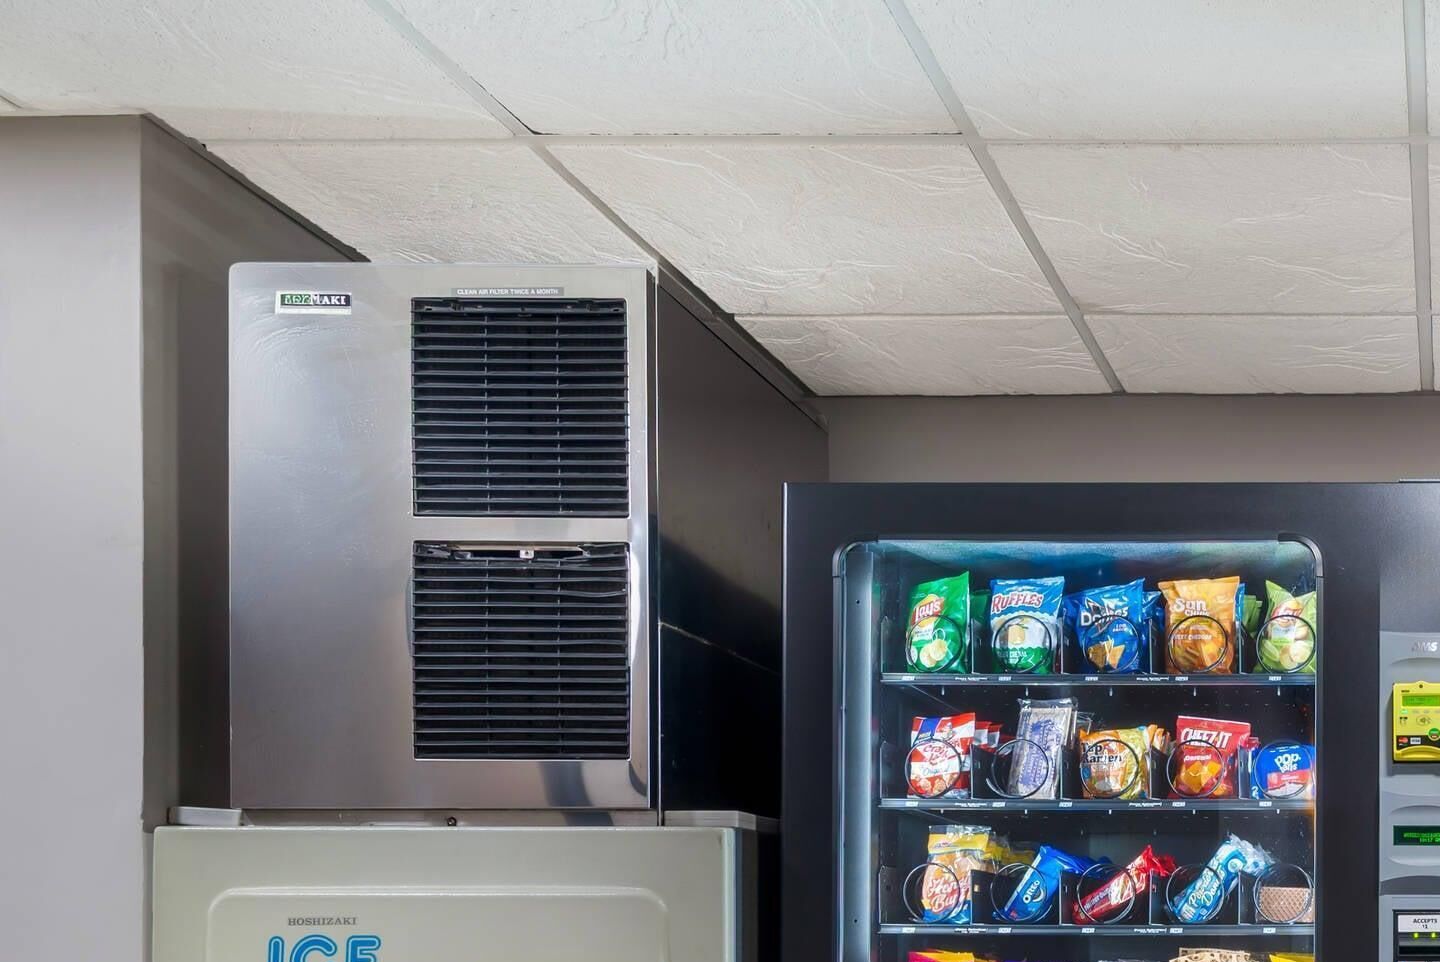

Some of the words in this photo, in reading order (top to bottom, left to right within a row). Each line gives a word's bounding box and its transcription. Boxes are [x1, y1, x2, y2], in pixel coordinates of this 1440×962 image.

[456, 288, 478, 296] CLEAN
[489, 288, 510, 296] FILTER
[536, 286, 559, 295] MONTH
[990, 590, 1044, 615] RUFFLES
[1022, 879, 1041, 904] OREO
[287, 917, 358, 927] HOSHIZAKI
